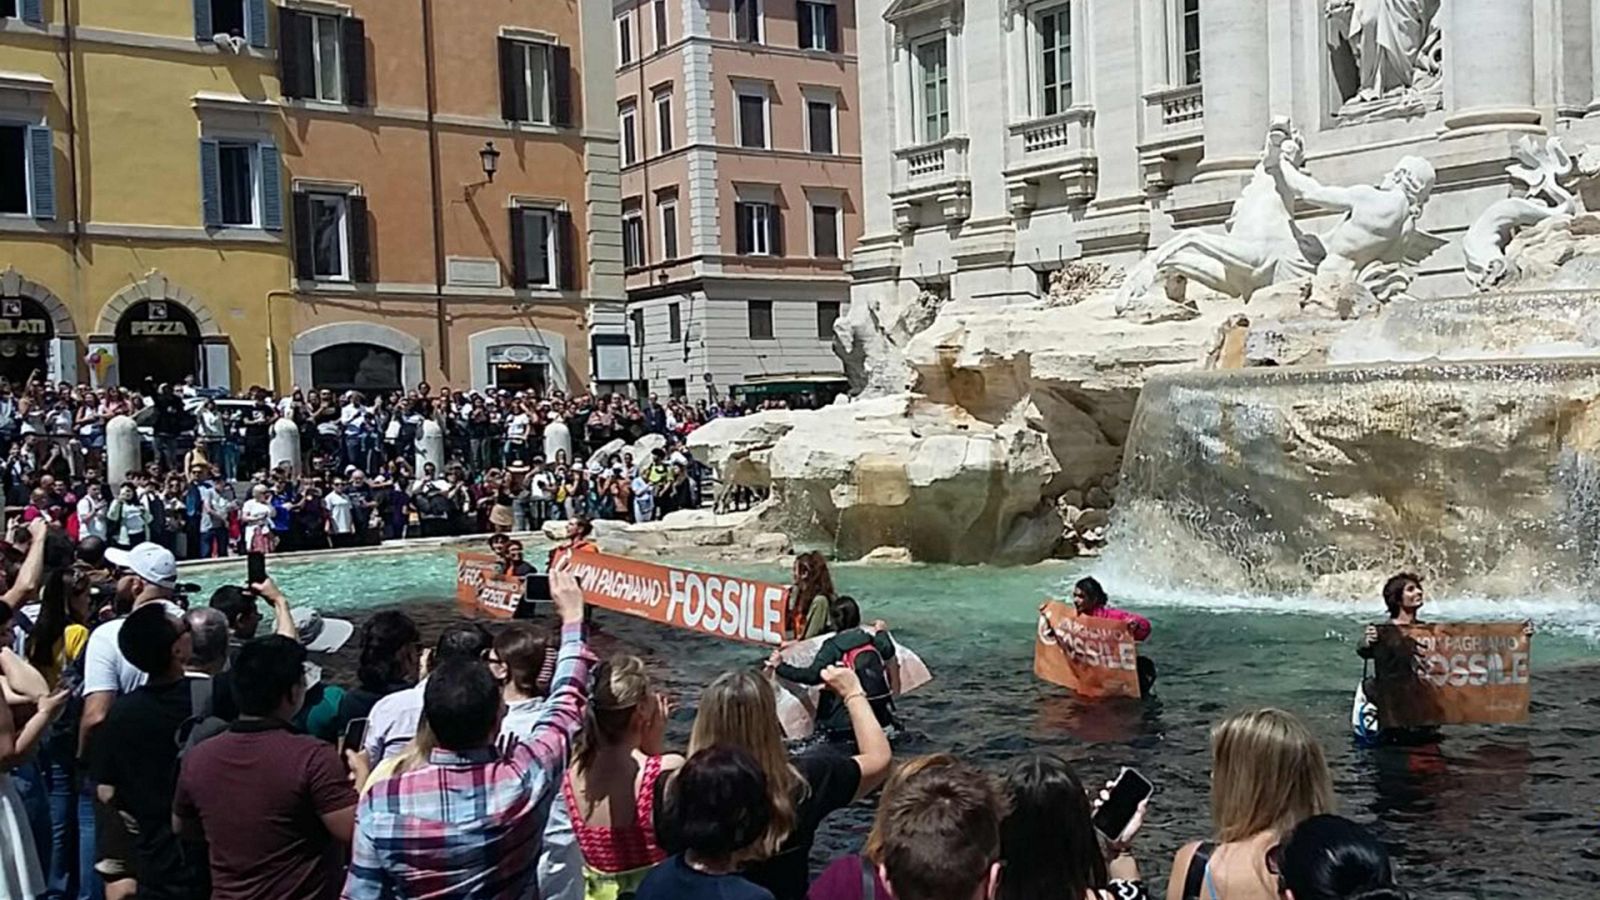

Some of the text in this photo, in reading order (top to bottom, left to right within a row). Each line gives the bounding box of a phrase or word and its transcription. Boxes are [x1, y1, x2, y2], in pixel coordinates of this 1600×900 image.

[131, 320, 188, 336] PIZZA
[599, 568, 662, 607] PAGHIAMO
[666, 569, 783, 643] FOSSILE
